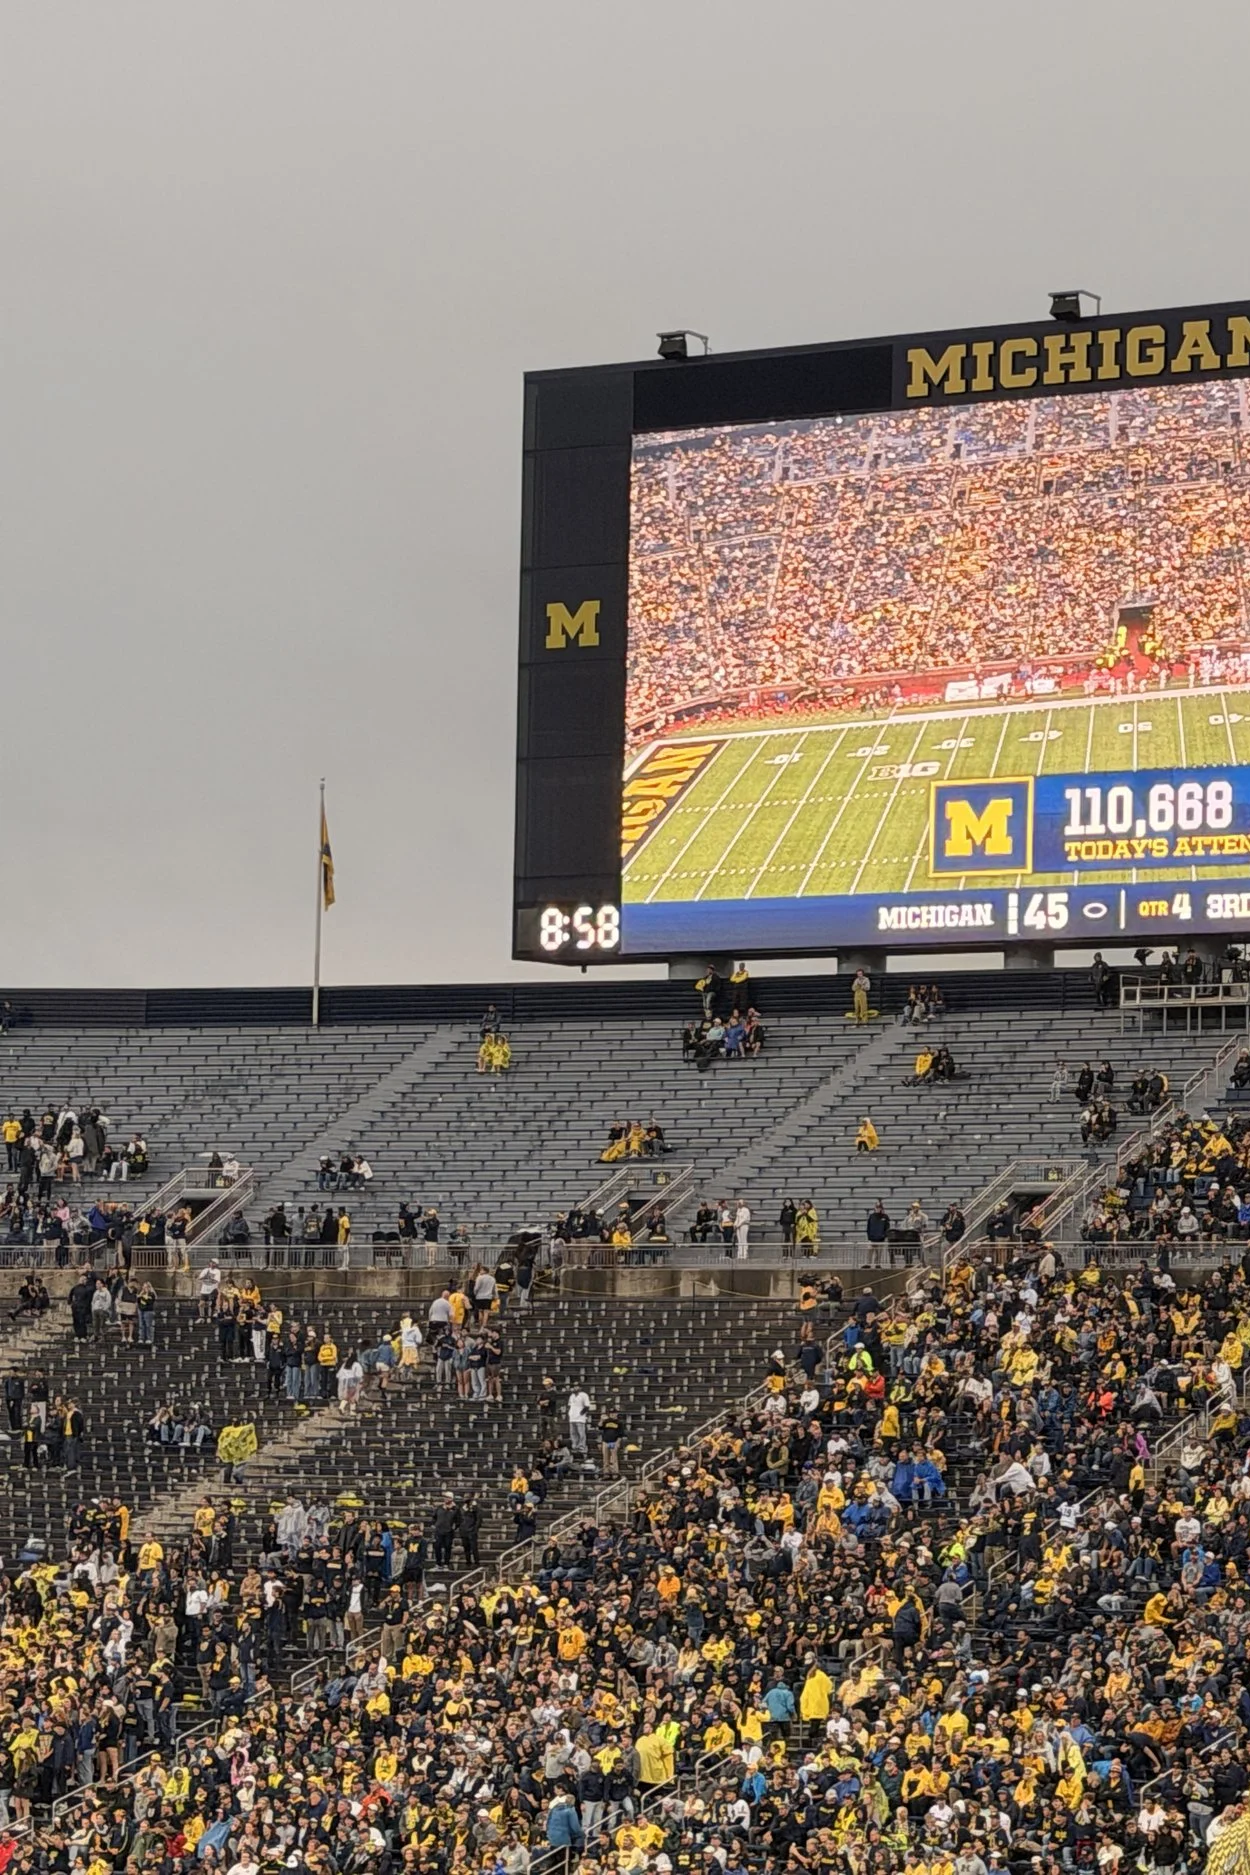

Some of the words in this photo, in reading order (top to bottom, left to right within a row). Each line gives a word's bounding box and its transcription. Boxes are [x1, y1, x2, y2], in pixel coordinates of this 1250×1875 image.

[546, 600, 600, 648] M
[944, 799, 1013, 857] M
[1063, 781, 1233, 838] 110,668
[1064, 838, 1168, 862] TODAY'S
[541, 905, 619, 951] 8:58
[878, 904, 994, 930] MICHIGAN
[1023, 893, 1069, 929] 45
[1138, 902, 1168, 917] QTR
[1171, 893, 1192, 920] 4
